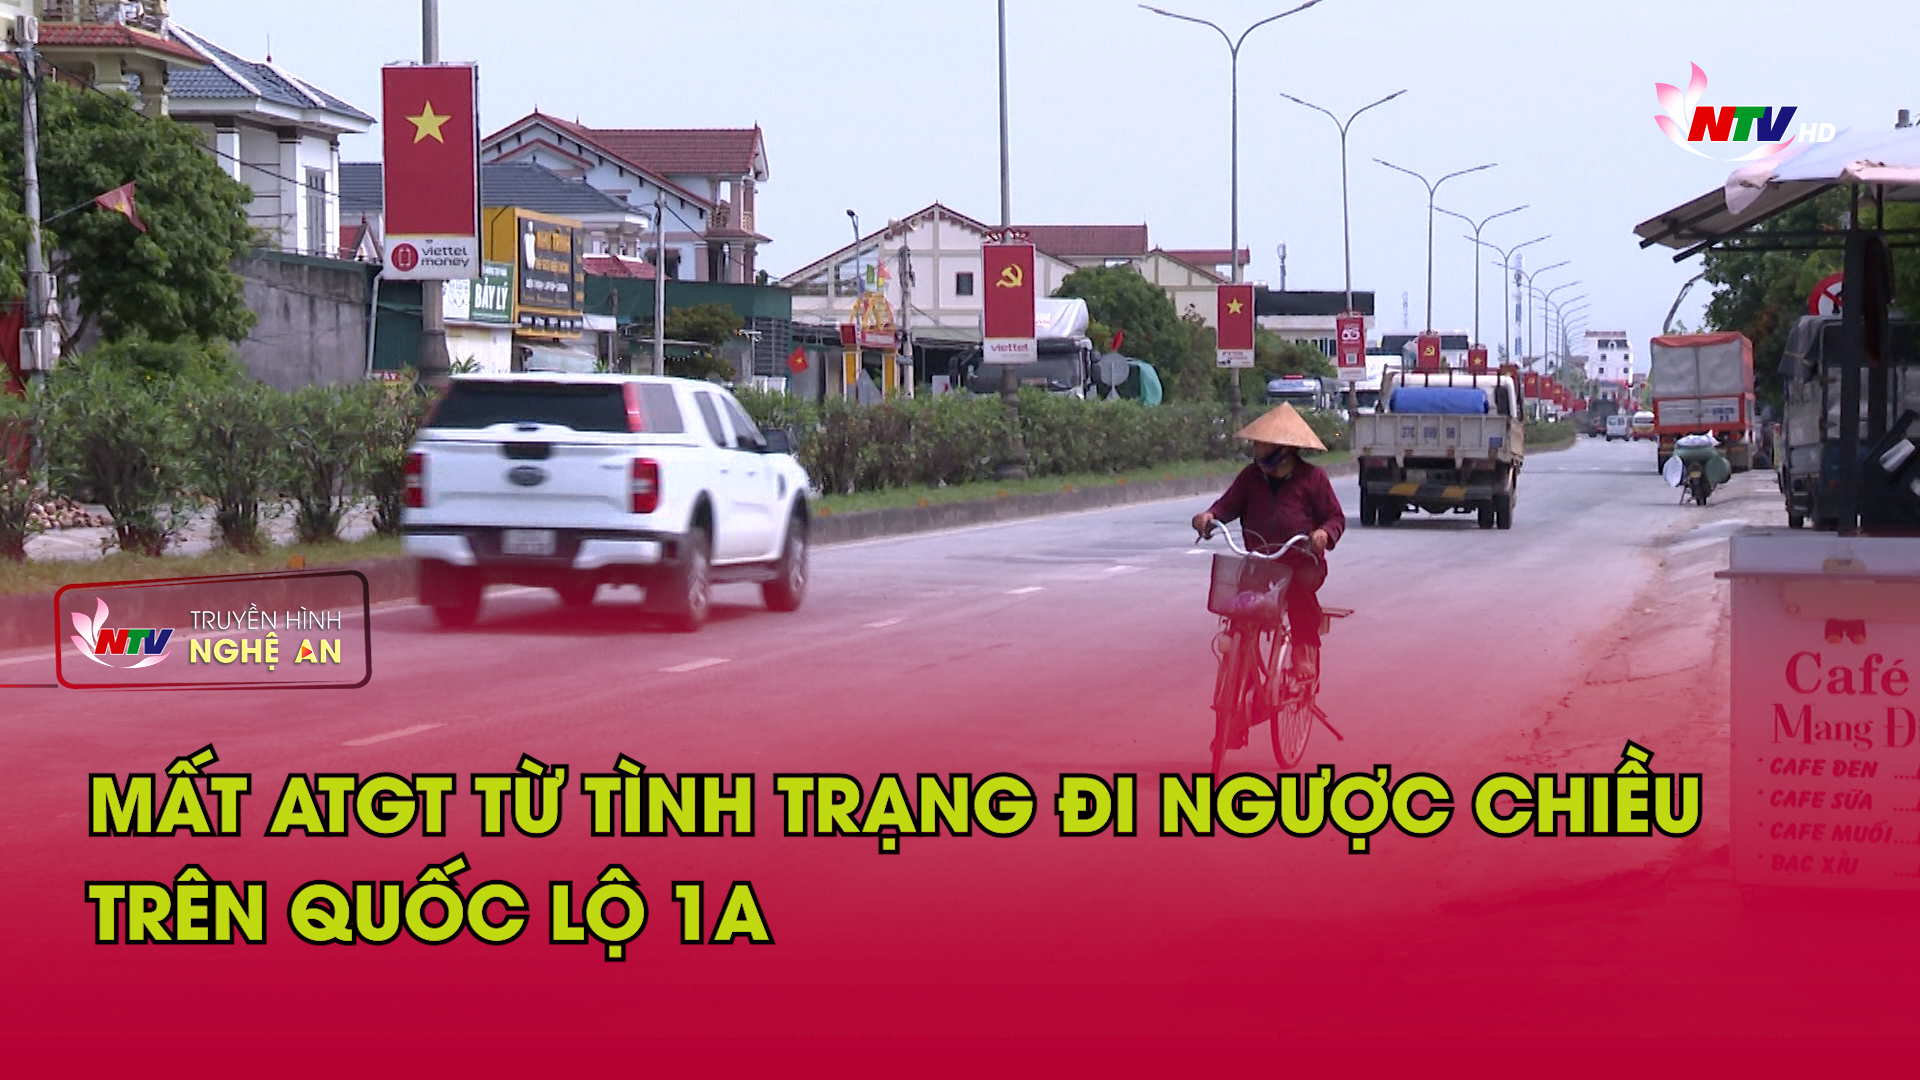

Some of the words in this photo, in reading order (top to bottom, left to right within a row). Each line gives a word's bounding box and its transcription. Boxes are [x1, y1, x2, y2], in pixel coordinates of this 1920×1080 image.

[420, 257, 470, 268] money
[421, 246, 469, 257] viettel
[495, 281, 509, 311] LÝ
[990, 343, 1029, 352] viettel
[1785, 651, 1910, 696] Café
[1770, 703, 1874, 752] Mang
[1882, 705, 1920, 749] Đ
[1769, 757, 1826, 776] CAFE
[1769, 789, 1826, 808] CAFE
[1830, 788, 1873, 811] SỮA
[1769, 821, 1826, 841] CAFE
[1831, 819, 1894, 844] MUỐI
